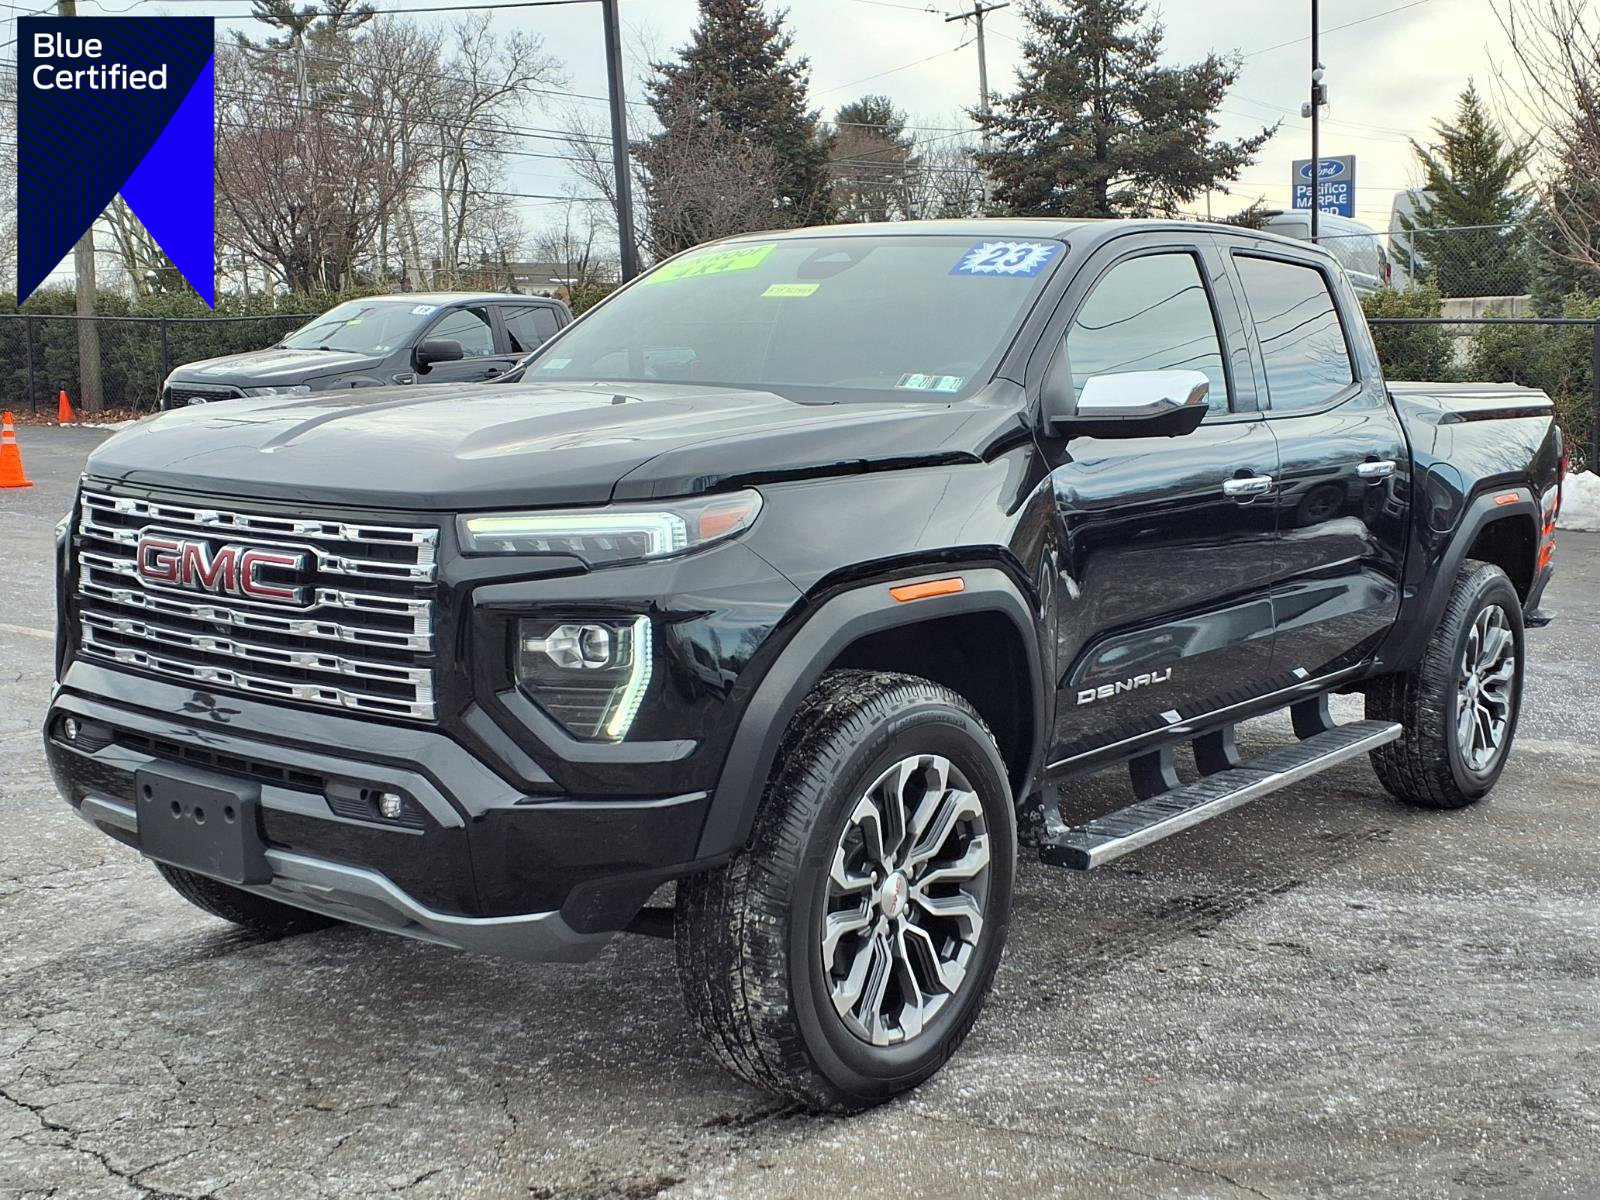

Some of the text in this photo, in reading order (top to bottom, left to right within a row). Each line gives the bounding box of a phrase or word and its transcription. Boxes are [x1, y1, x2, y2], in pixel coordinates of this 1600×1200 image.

[1296, 182, 1347, 197] Paifico
[976, 247, 1033, 267] 23
[137, 535, 306, 605] GMC
[1076, 667, 1173, 705] DENALI
